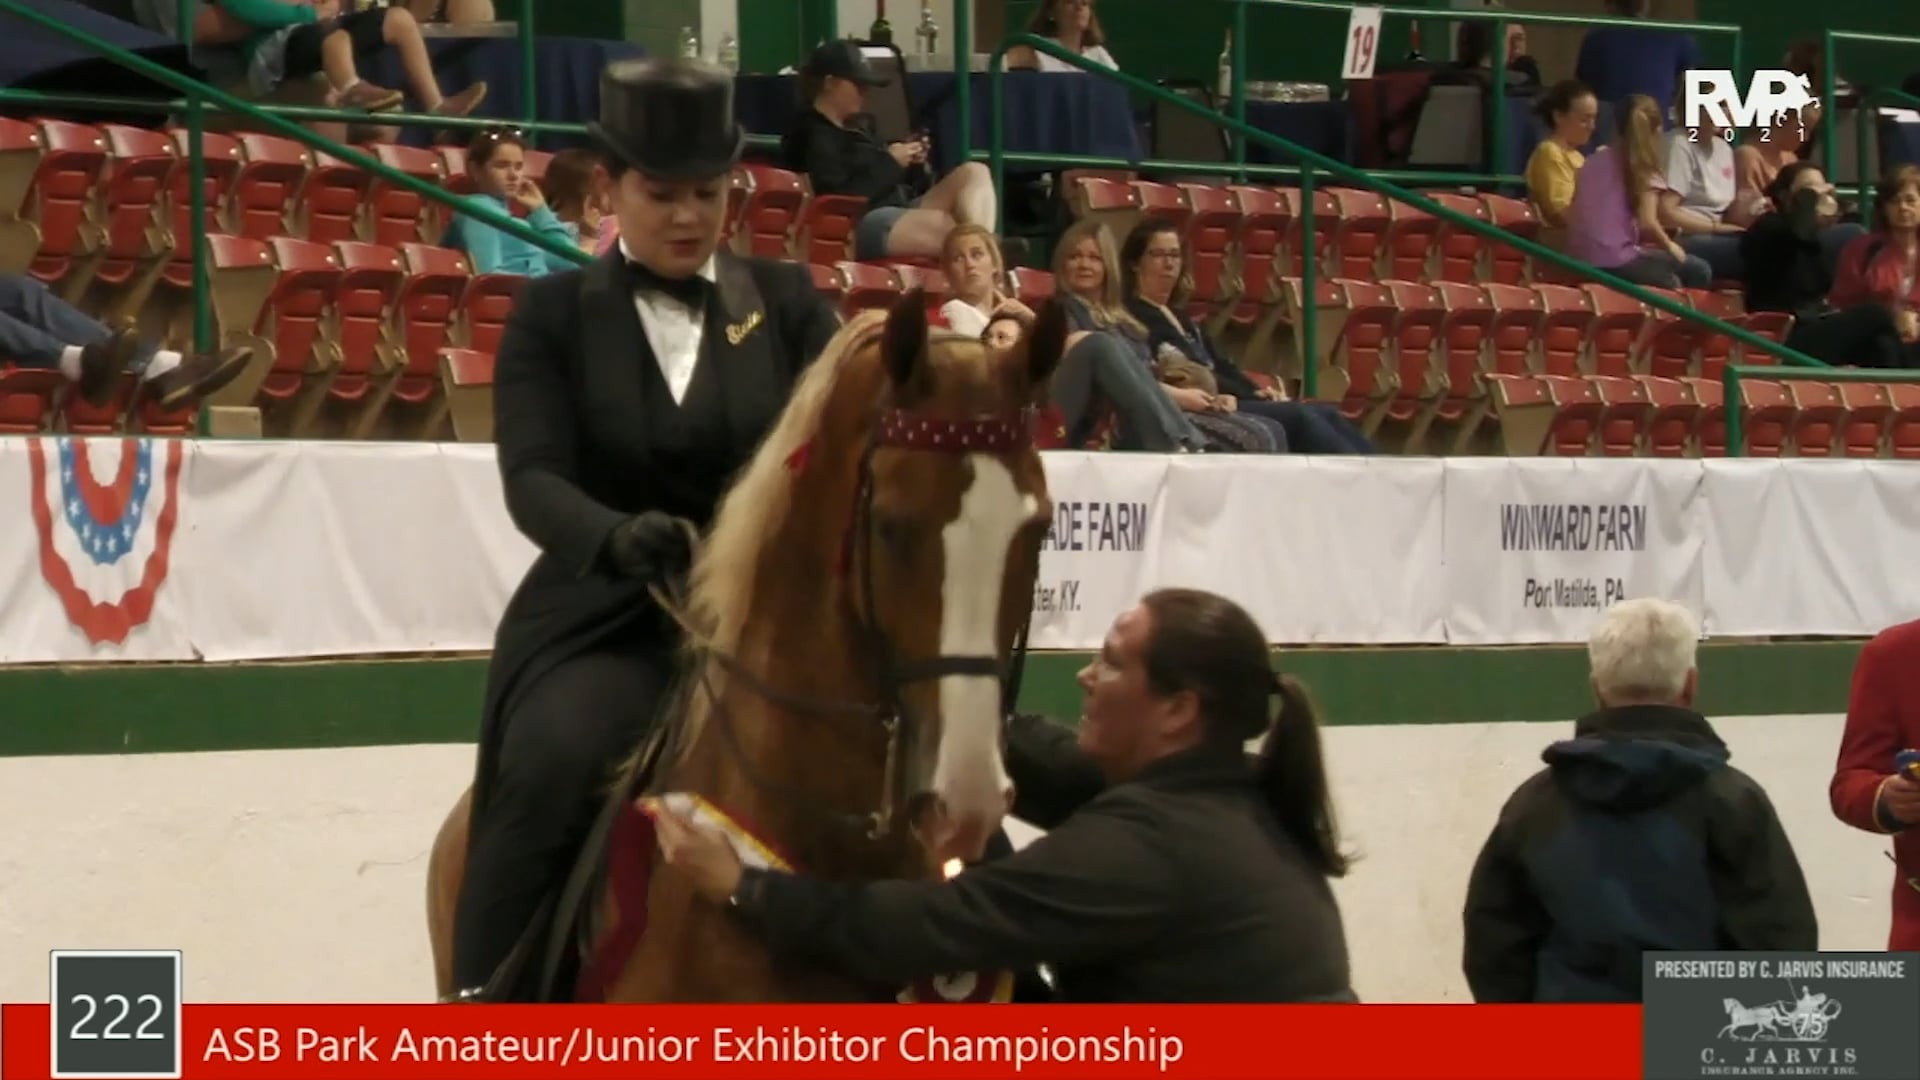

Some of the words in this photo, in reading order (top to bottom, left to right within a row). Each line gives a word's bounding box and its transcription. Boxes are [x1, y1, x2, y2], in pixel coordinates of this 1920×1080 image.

[1350, 25, 1375, 74] 19
[1088, 502, 1147, 551] FARM
[1500, 503, 1593, 551] WINWARD
[1596, 504, 1647, 551] FARM
[1060, 580, 1081, 611] KY.
[1524, 578, 1553, 608] Port
[1554, 578, 1601, 612] Matilda,
